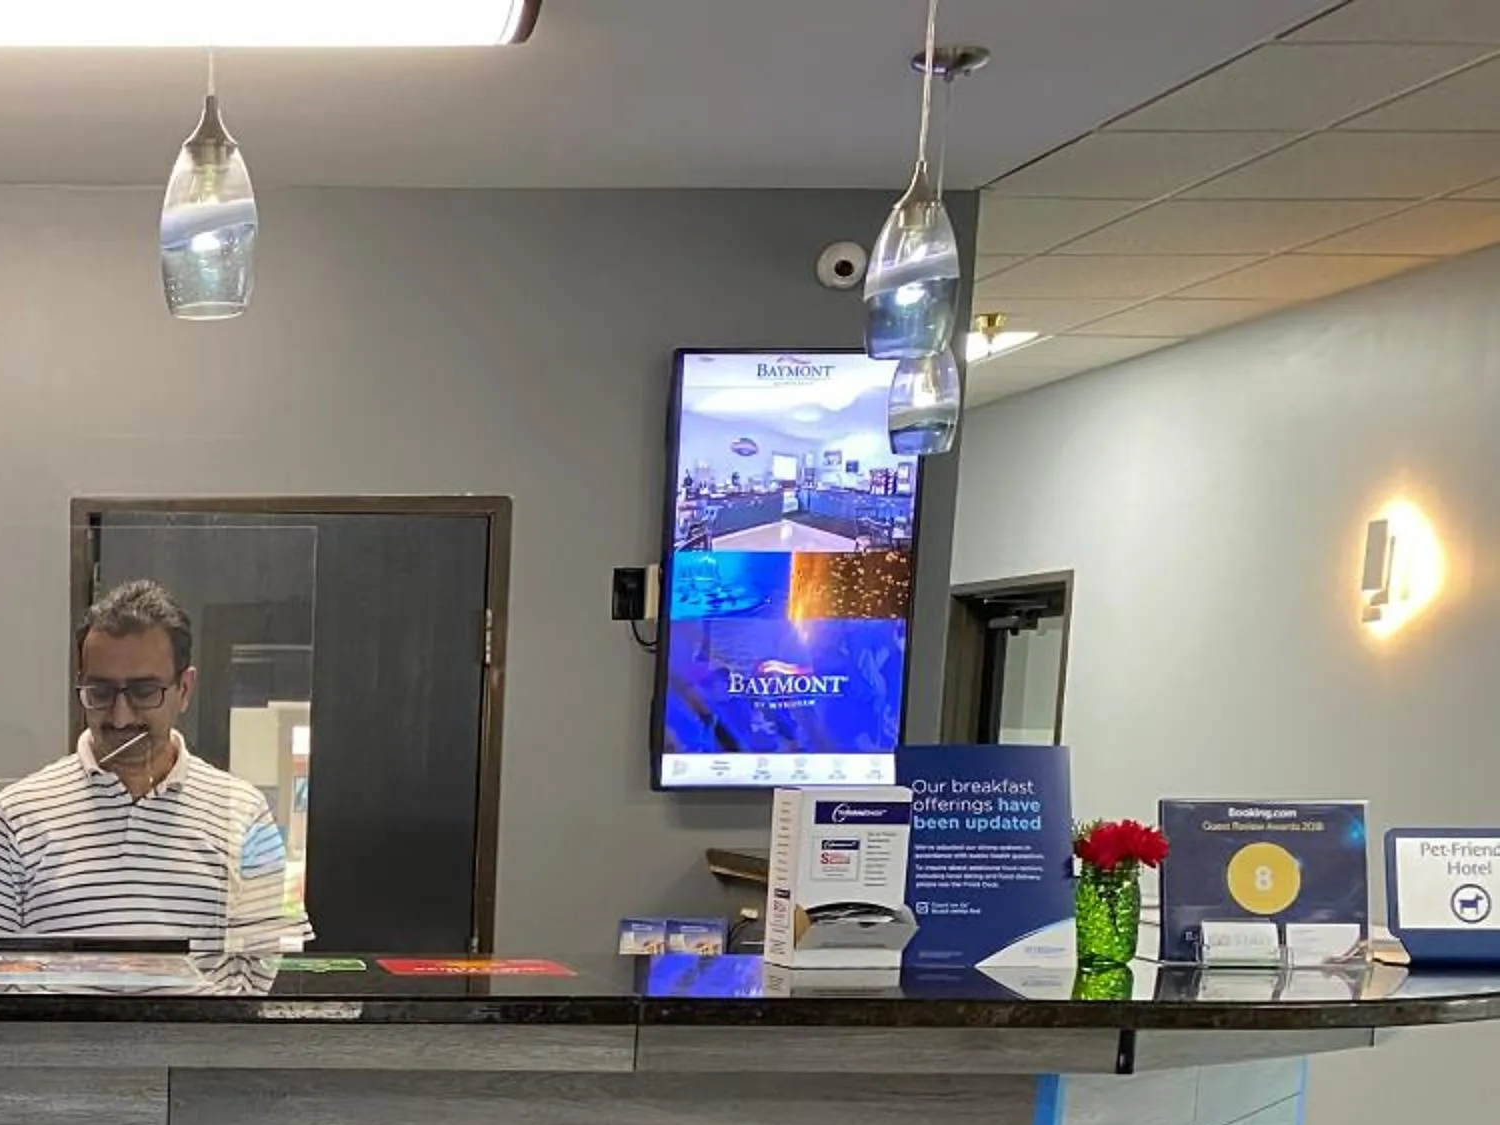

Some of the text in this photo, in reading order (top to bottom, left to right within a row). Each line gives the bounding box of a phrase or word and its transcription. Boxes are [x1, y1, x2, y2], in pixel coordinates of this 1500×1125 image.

[756, 363, 832, 378] BAYMONT
[728, 672, 843, 694] BAYMONT
[911, 779, 1035, 795] Our breakfast
[912, 797, 1041, 814] offerings have
[1228, 806, 1297, 820] Booking.com
[913, 815, 1043, 833] been updated
[1446, 860, 1493, 876] Hotel
[1253, 865, 1275, 892] 8
